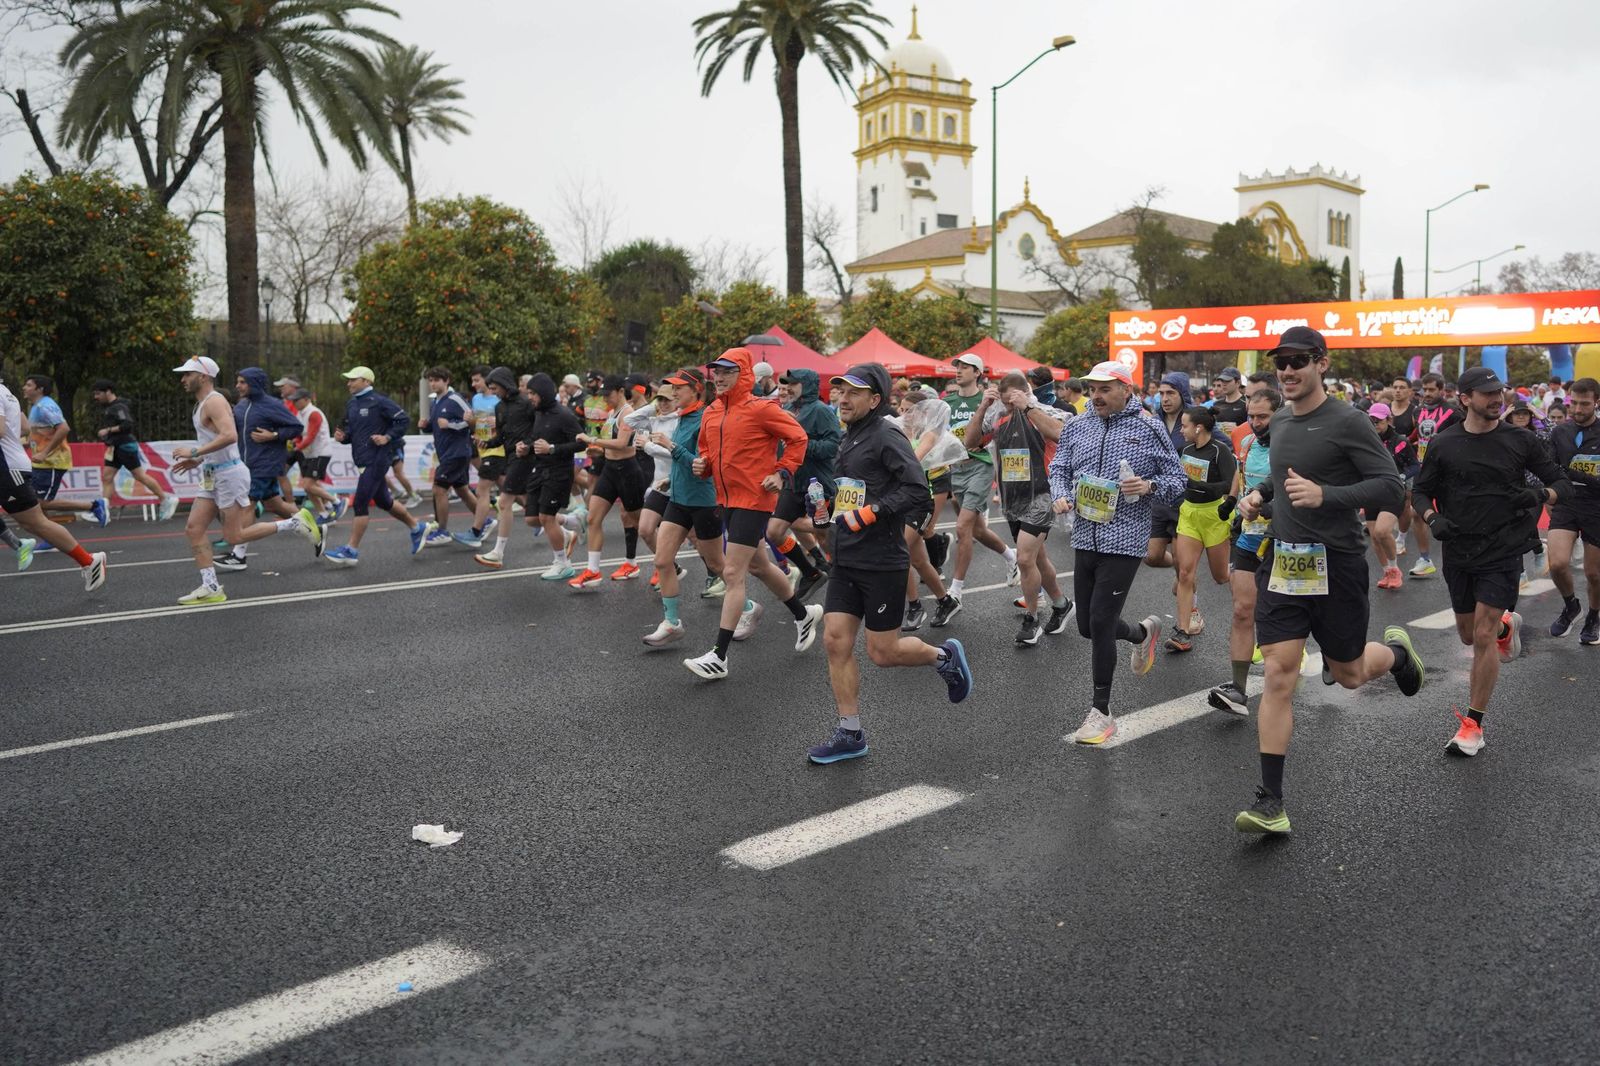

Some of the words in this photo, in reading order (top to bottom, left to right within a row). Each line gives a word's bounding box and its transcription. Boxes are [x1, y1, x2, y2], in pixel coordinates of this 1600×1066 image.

[1375, 306, 1450, 324] maratón
[1542, 306, 1600, 326] HOKA
[1079, 484, 1111, 504] 10085
[1277, 554, 1316, 572] 13264
